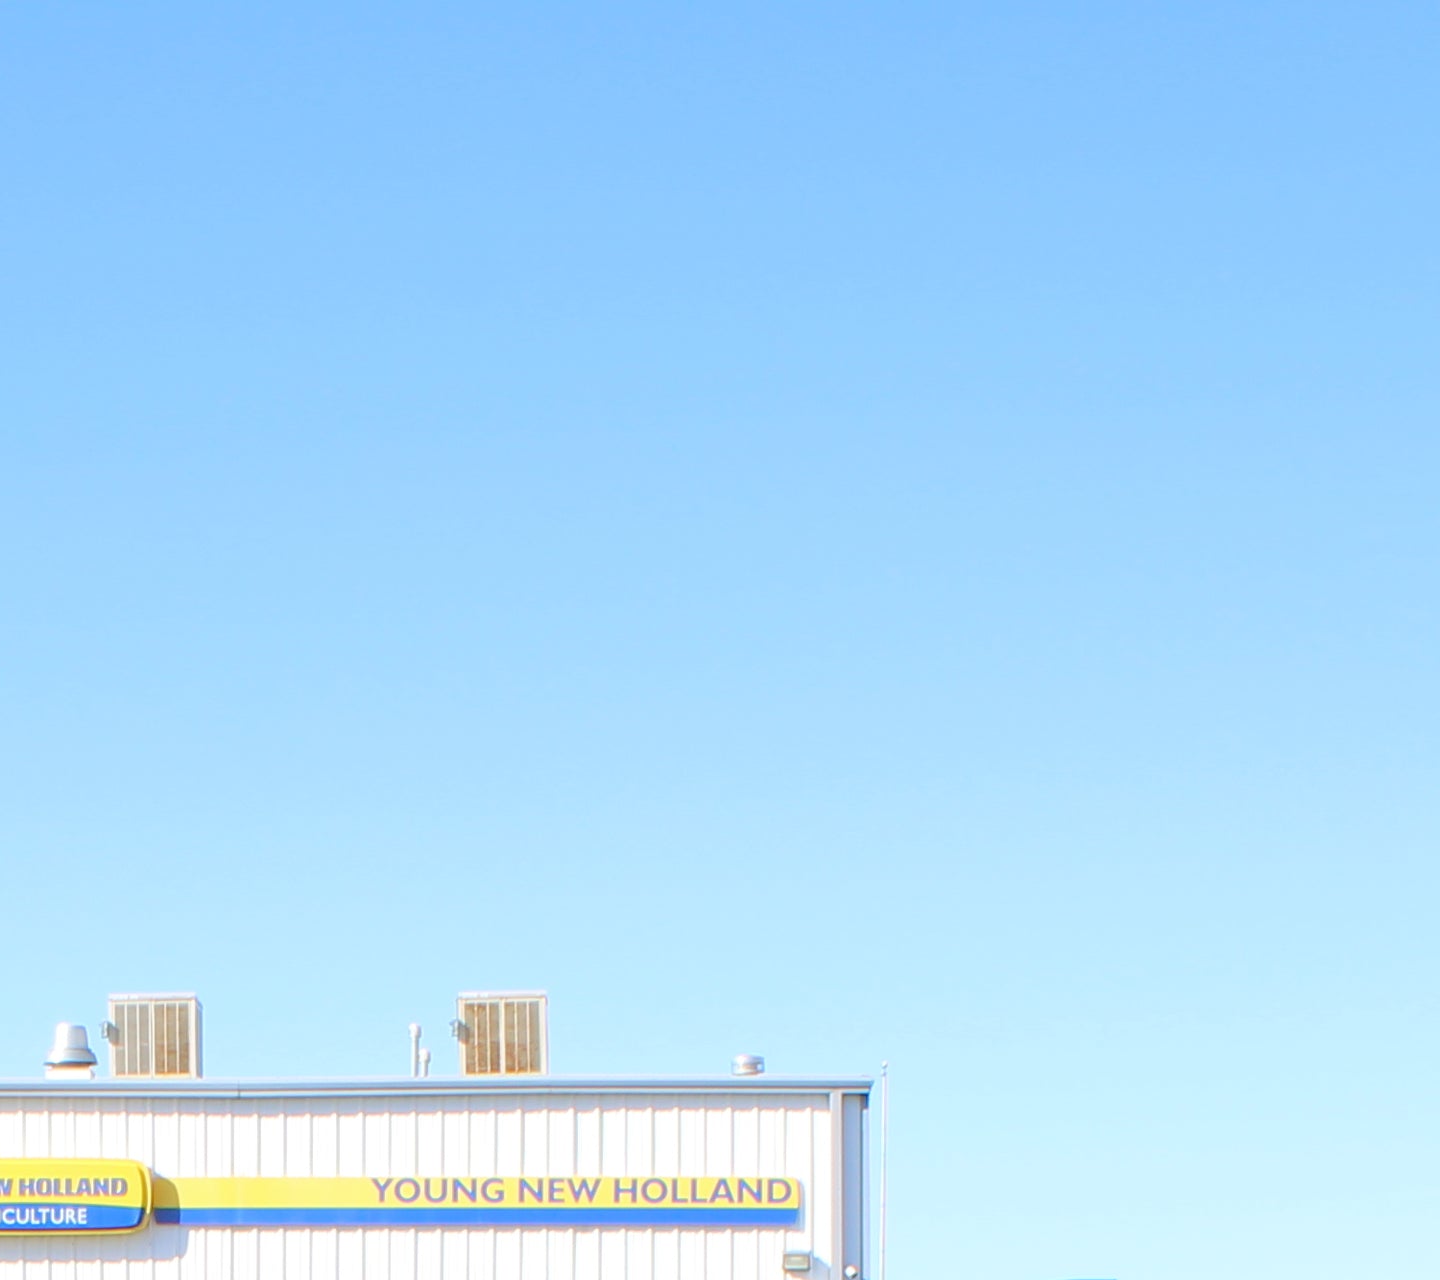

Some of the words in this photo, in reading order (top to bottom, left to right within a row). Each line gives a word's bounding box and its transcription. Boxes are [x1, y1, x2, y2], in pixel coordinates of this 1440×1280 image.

[18, 1177, 129, 1198] HOLLAND
[371, 1177, 506, 1203] YOUNG
[519, 1177, 601, 1203] NEW
[613, 1177, 793, 1204] HOLLAND
